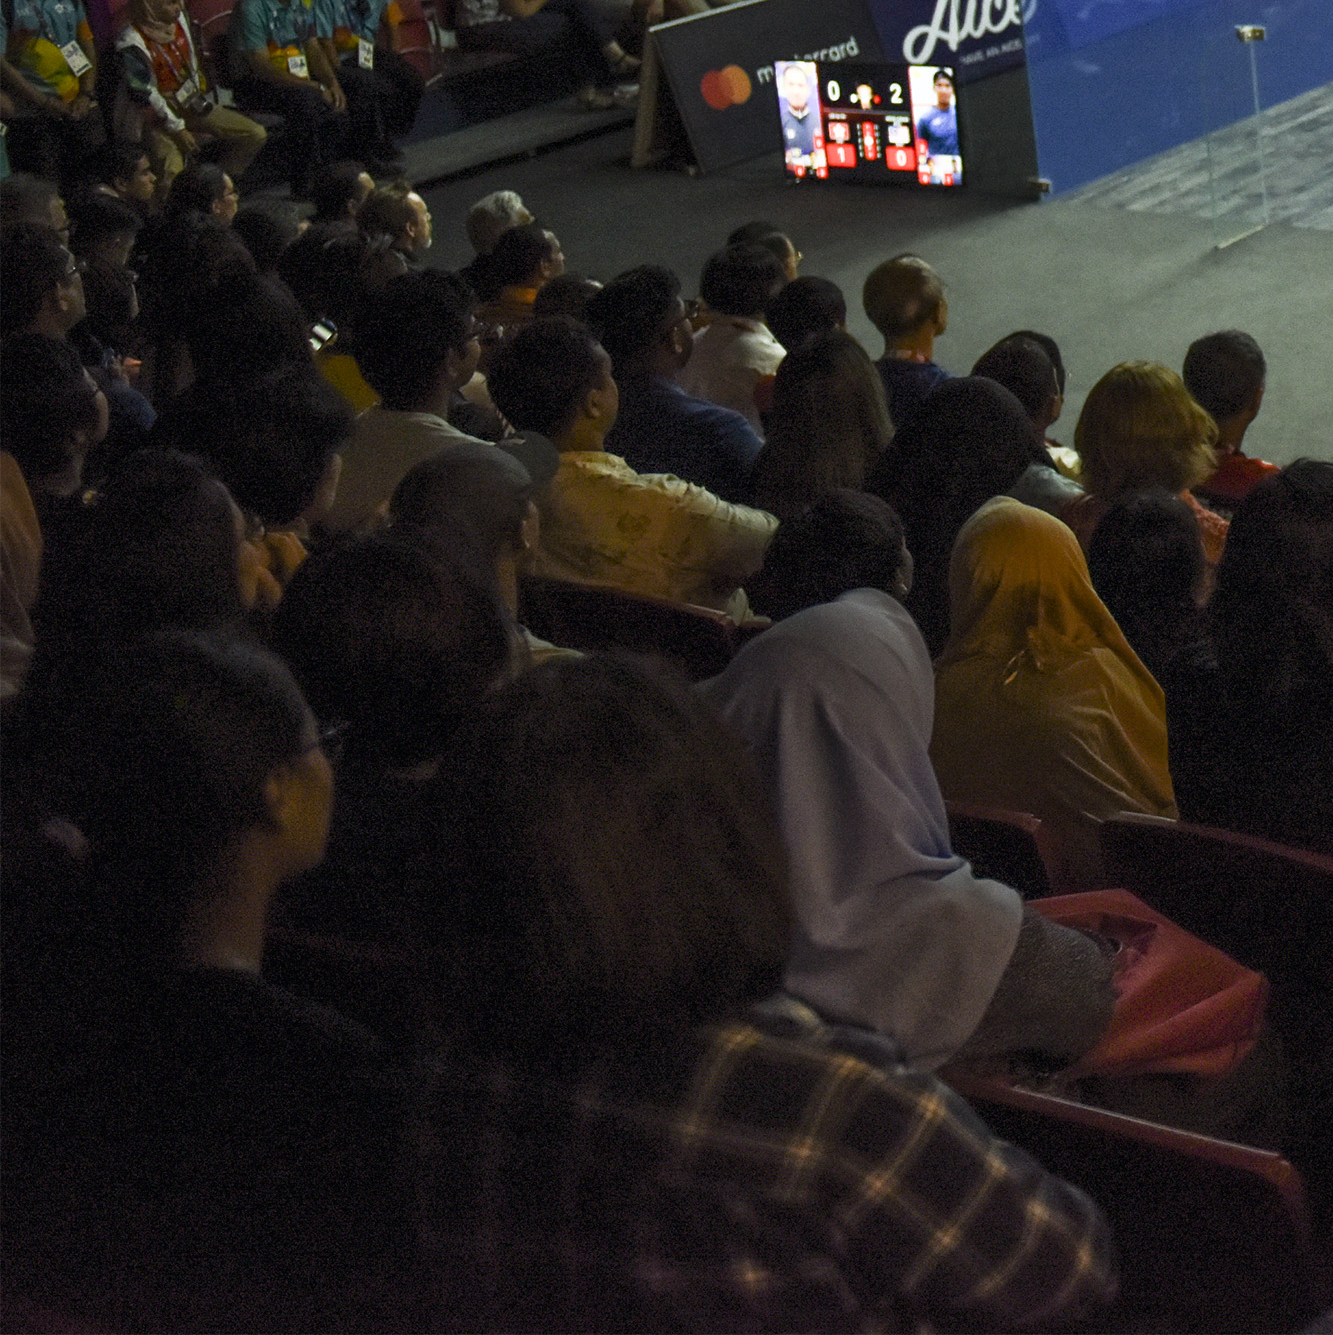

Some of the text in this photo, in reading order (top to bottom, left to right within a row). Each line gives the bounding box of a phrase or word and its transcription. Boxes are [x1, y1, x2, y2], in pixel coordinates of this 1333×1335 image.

[827, 80, 841, 102] 0
[889, 82, 904, 104] 2
[836, 147, 846, 164] 1
[896, 151, 907, 167] 0
